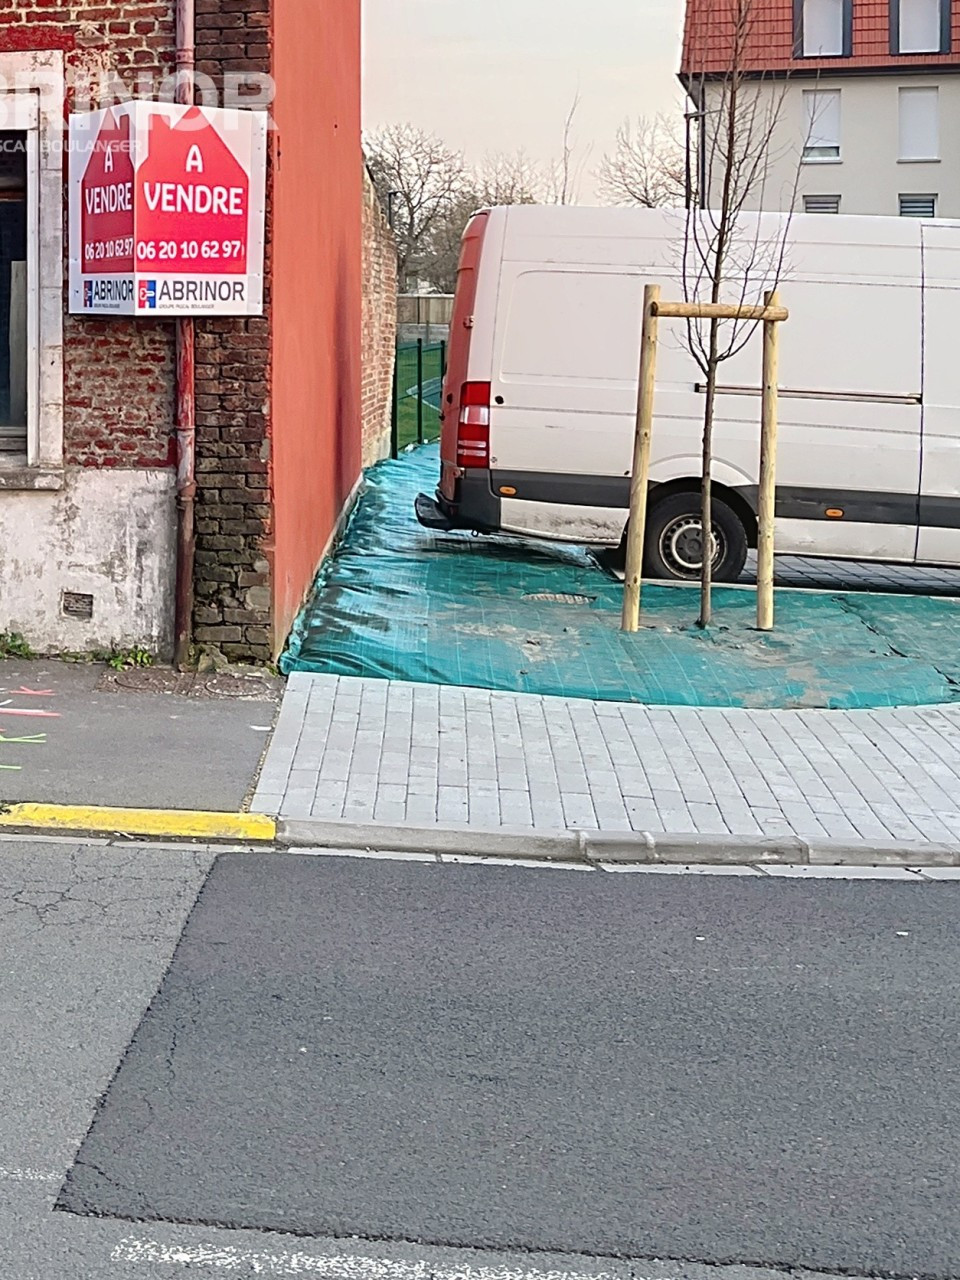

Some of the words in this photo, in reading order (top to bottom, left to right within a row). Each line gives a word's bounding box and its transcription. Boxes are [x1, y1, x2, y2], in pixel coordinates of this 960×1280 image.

[104, 145, 114, 173] A
[185, 144, 204, 173] A
[85, 182, 133, 215] VENDRE
[143, 182, 245, 216] VENDRE
[85, 243, 95, 261] 06
[95, 242, 105, 260] 20
[105, 240, 115, 258] 10
[115, 239, 124, 257] 62
[124, 237, 134, 256] 97
[137, 241, 156, 260] 06
[158, 241, 177, 260] 20
[180, 241, 199, 259] 10
[201, 240, 220, 259] 62
[222, 240, 242, 259] 97
[93, 279, 135, 302] ABRINOR
[158, 280, 246, 302] ABRINOR
